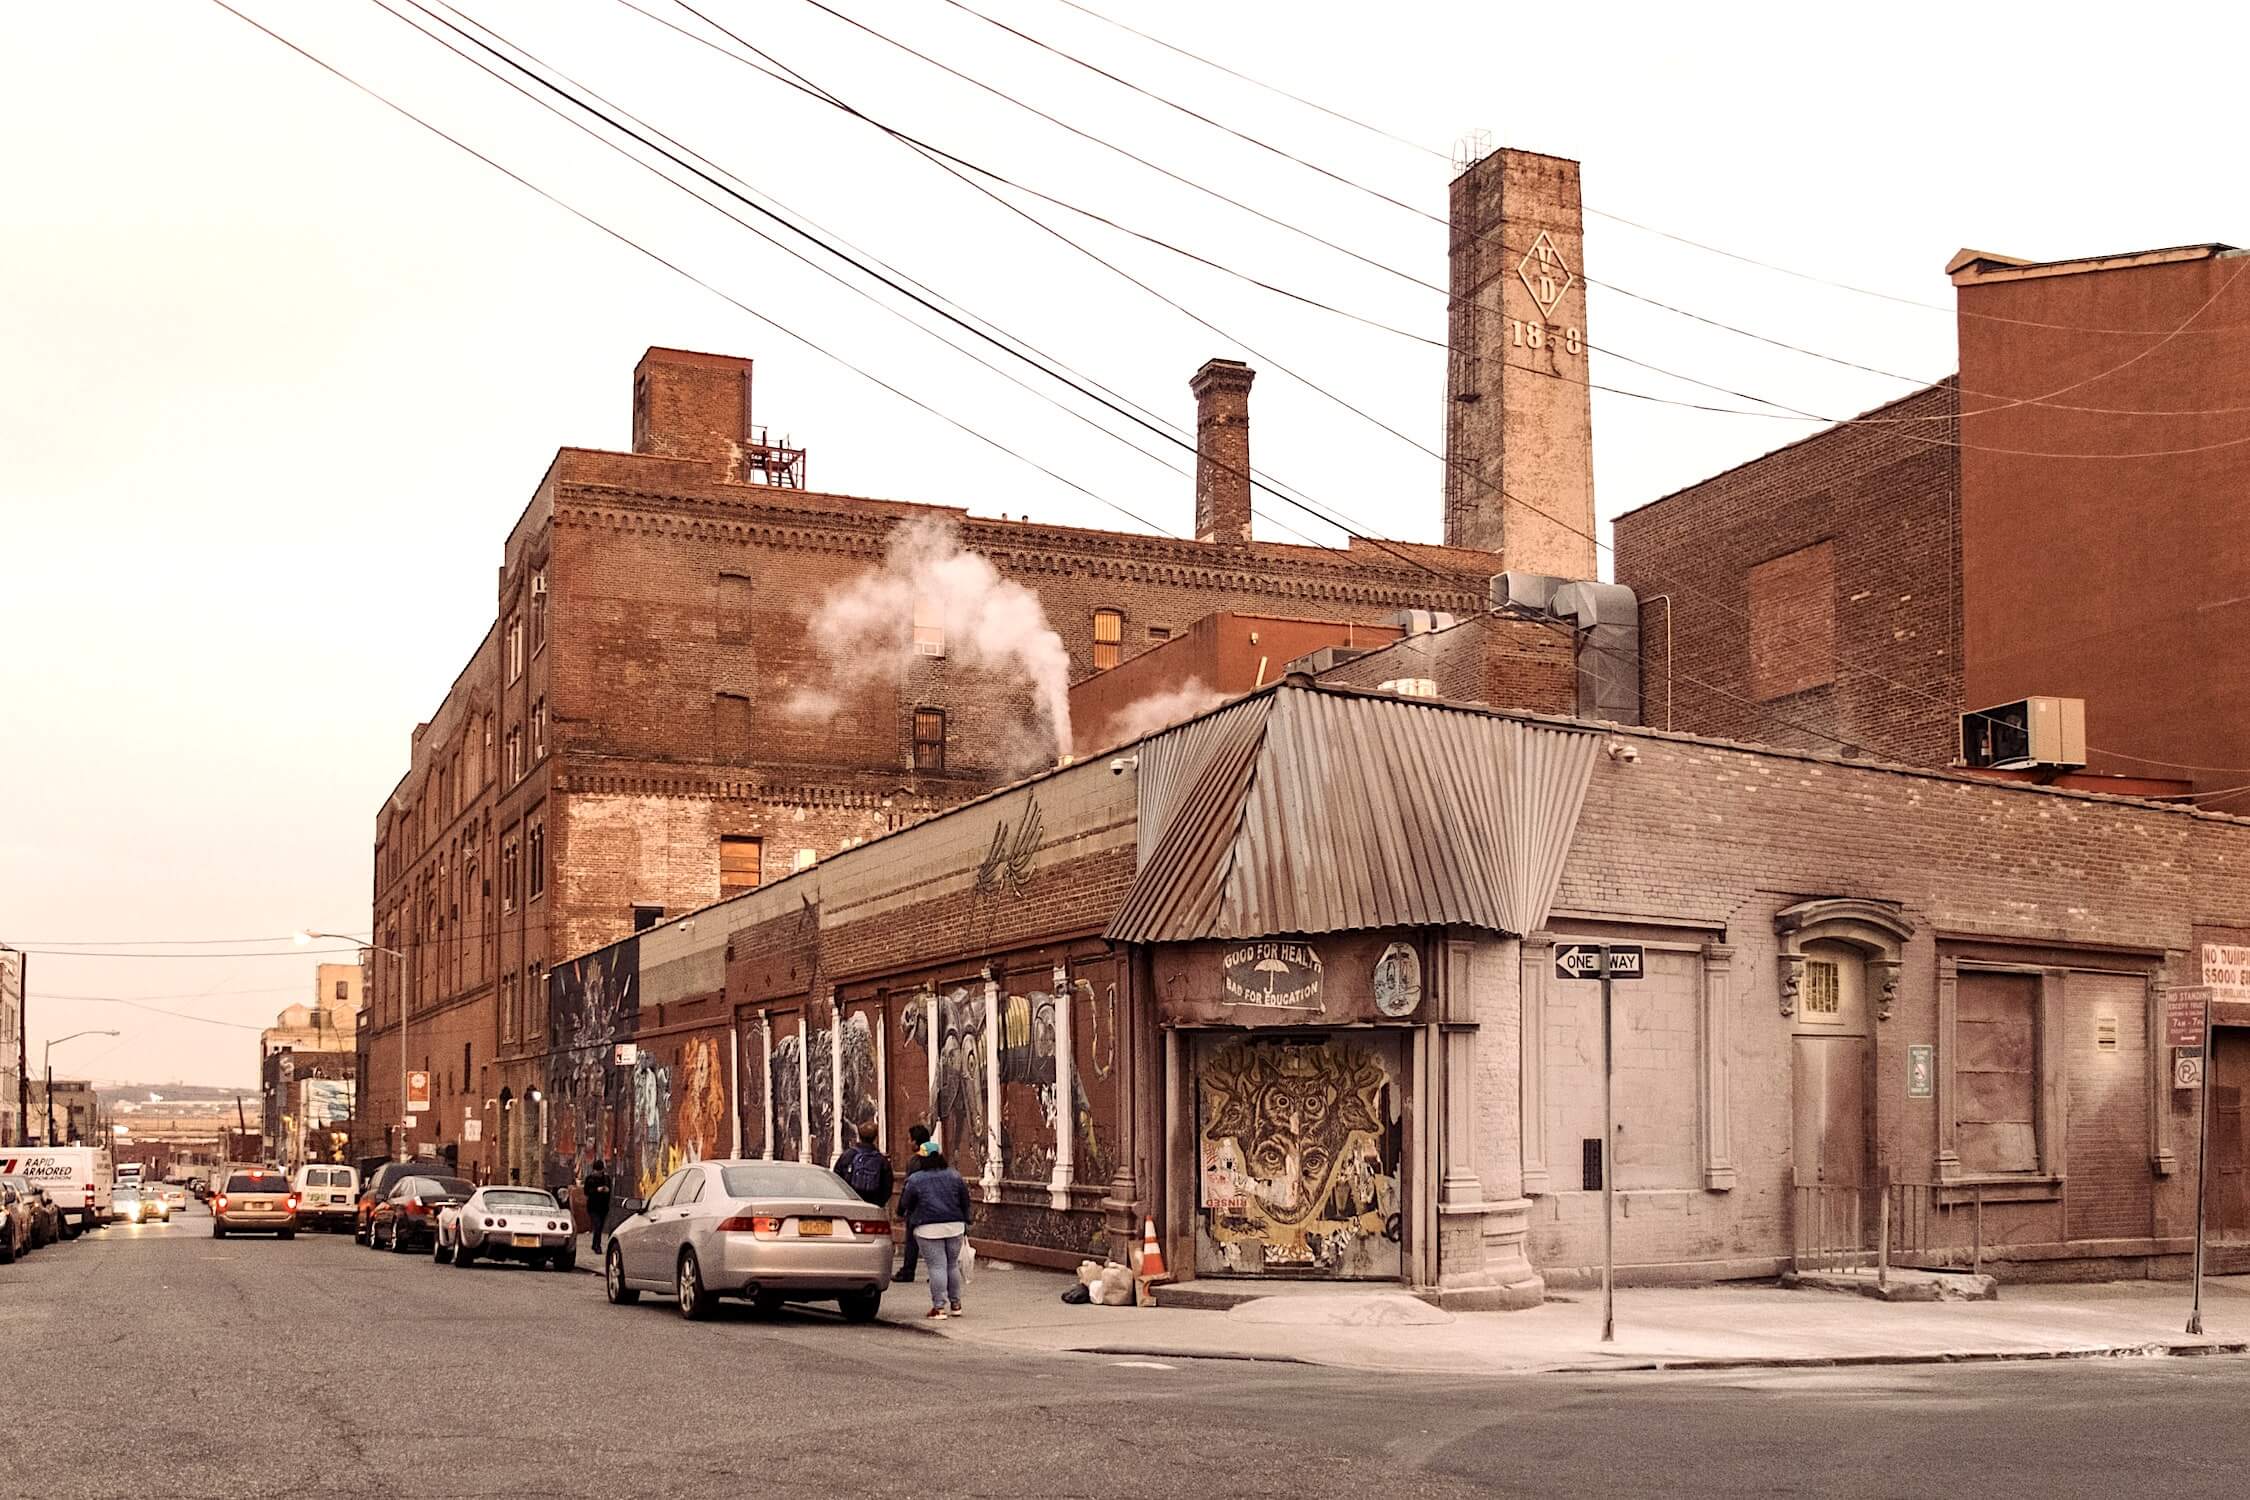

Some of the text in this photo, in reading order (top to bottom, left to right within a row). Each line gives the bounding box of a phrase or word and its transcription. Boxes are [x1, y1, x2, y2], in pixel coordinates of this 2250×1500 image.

[1512, 320, 1581, 354] 188
[1225, 946, 1254, 969] GOOD
[1257, 943, 1278, 960] FOR
[1567, 955, 1635, 969] ONE WAY
[2204, 948, 2217, 964] NO
[1226, 976, 1318, 1005] BAD FOR EDUCATION
[25, 1158, 55, 1166] RAPID
[23, 1166, 72, 1176] ARMORED
